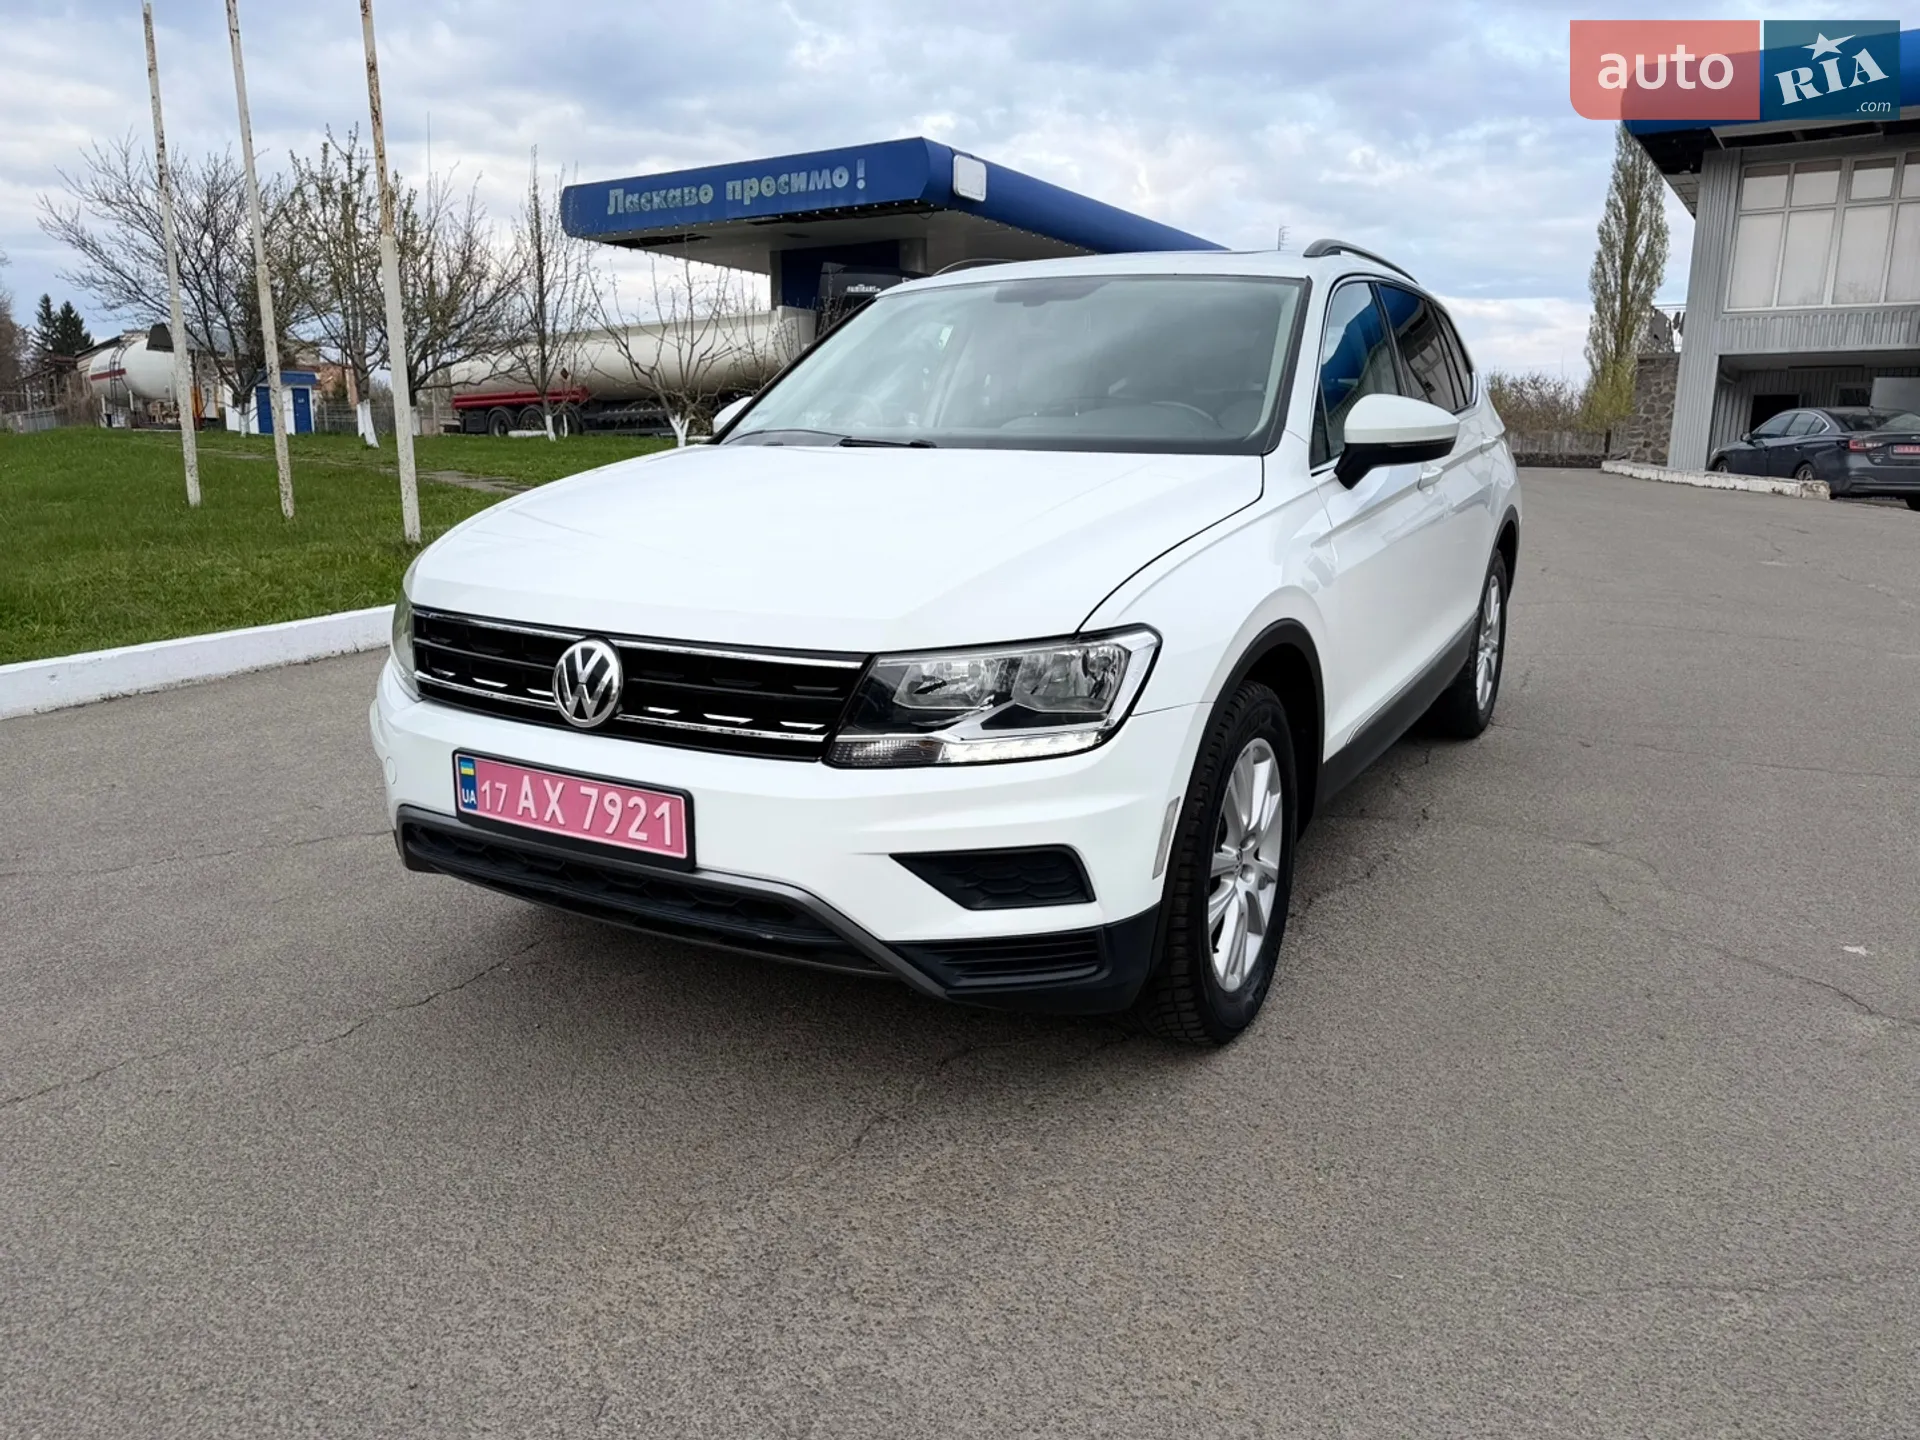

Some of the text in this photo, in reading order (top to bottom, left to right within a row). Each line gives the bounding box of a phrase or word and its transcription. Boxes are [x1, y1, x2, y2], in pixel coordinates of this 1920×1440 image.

[607, 184, 714, 215] Ласкаво
[461, 788, 477, 804] UA
[481, 775, 672, 846] 17 AX 7921
